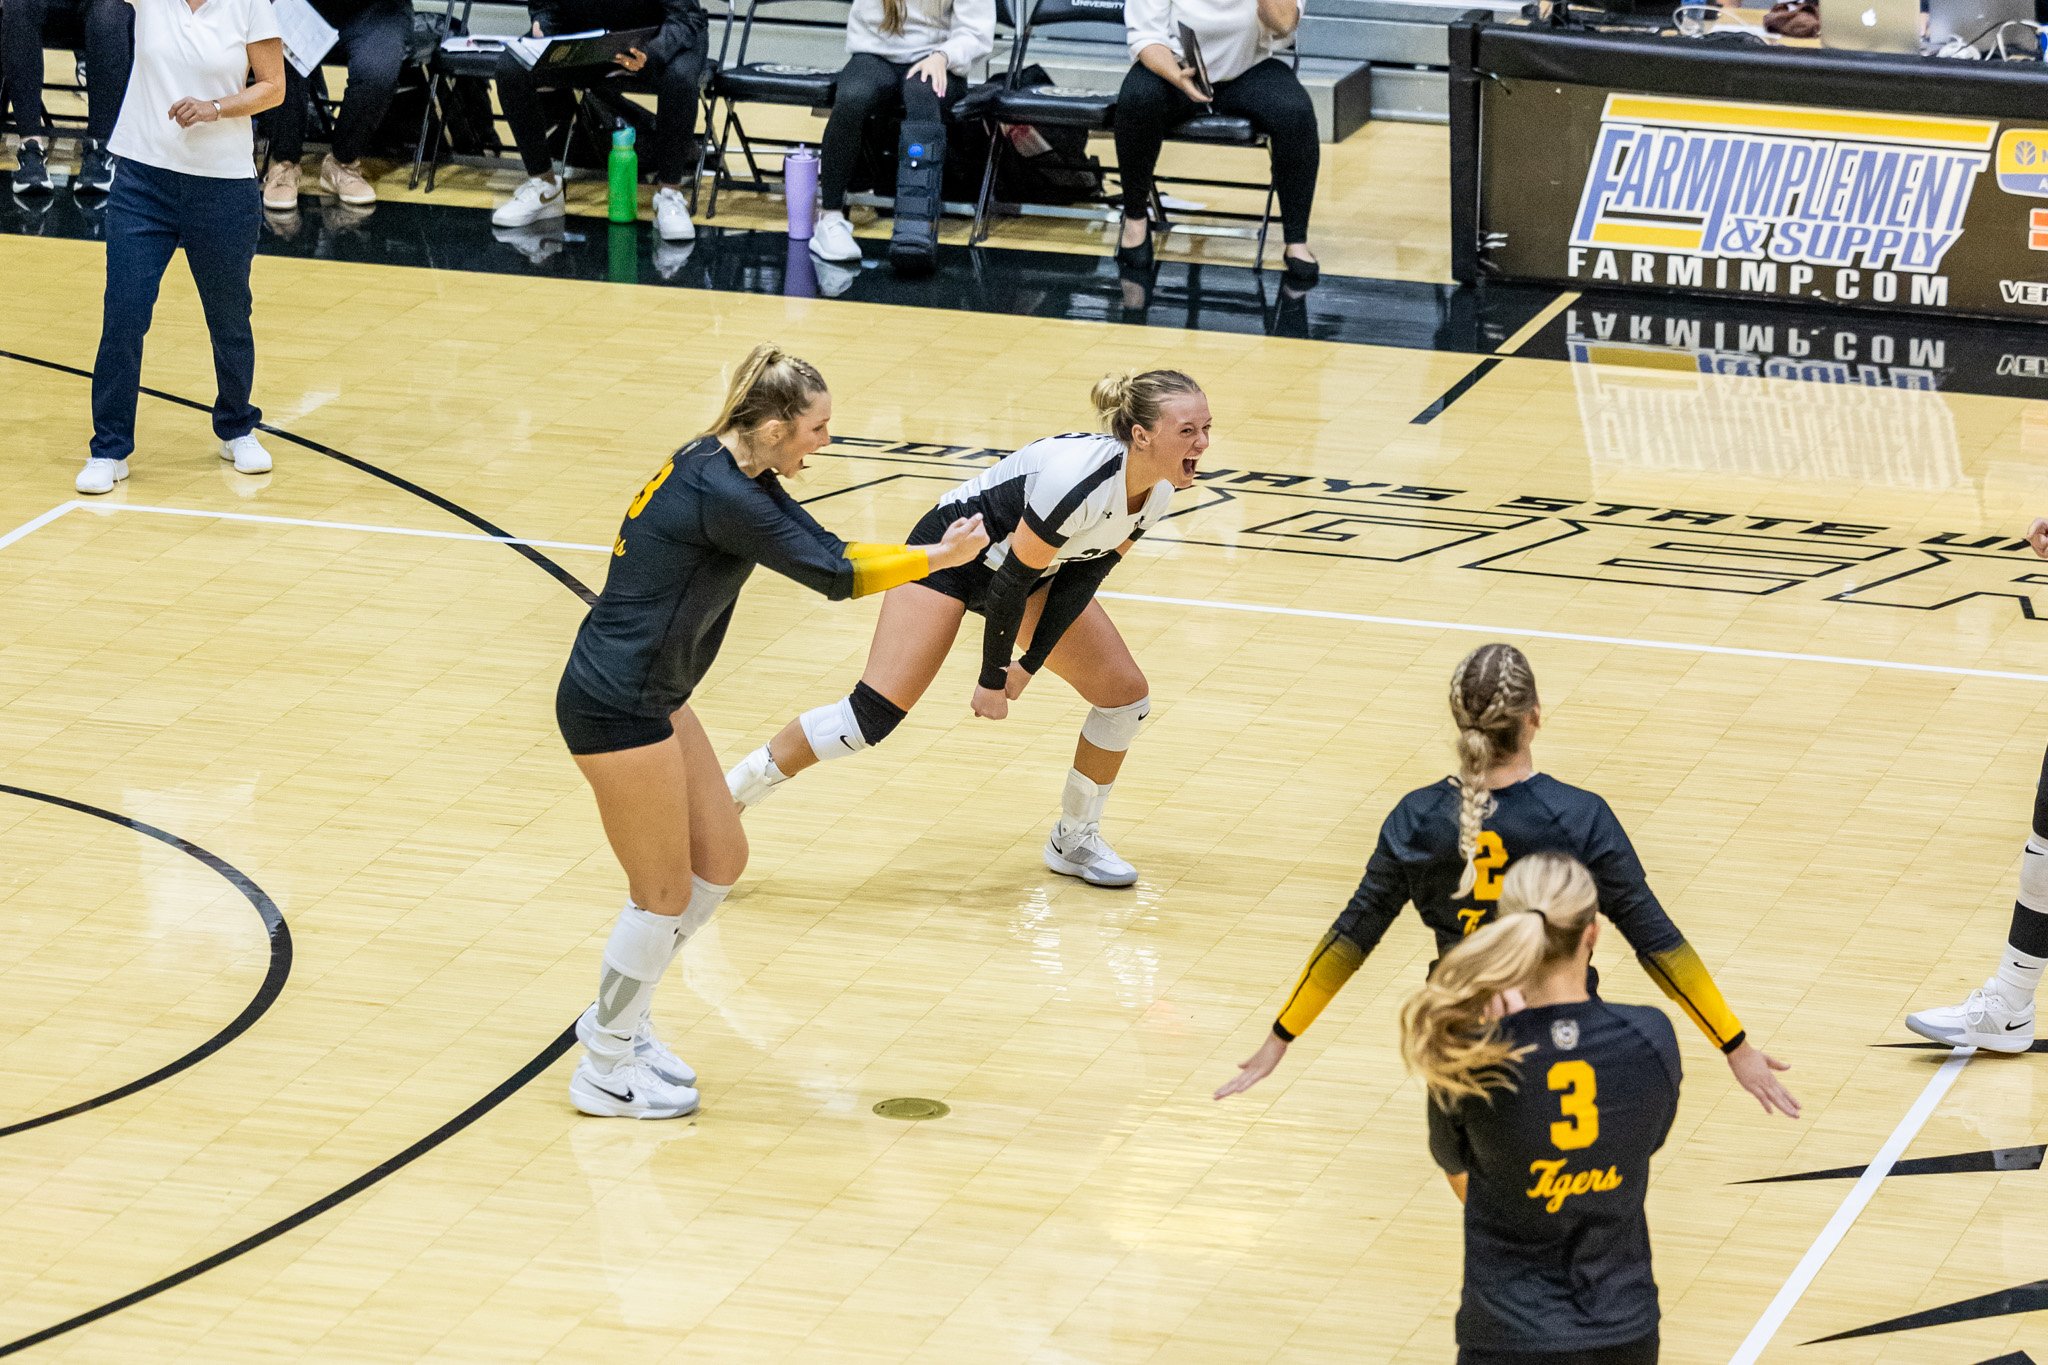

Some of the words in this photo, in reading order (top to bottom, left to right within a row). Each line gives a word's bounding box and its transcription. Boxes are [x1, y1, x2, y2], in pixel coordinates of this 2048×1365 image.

[1720, 217, 1773, 254] &
[1774, 221, 1953, 269] SUPPLY
[1567, 247, 1949, 307] FARMIMP.COM
[1495, 495, 1891, 538] STATE
[1472, 830, 1509, 901] 2
[1547, 1059, 1600, 1151] 3
[1526, 1158, 1624, 1214] Tigers
